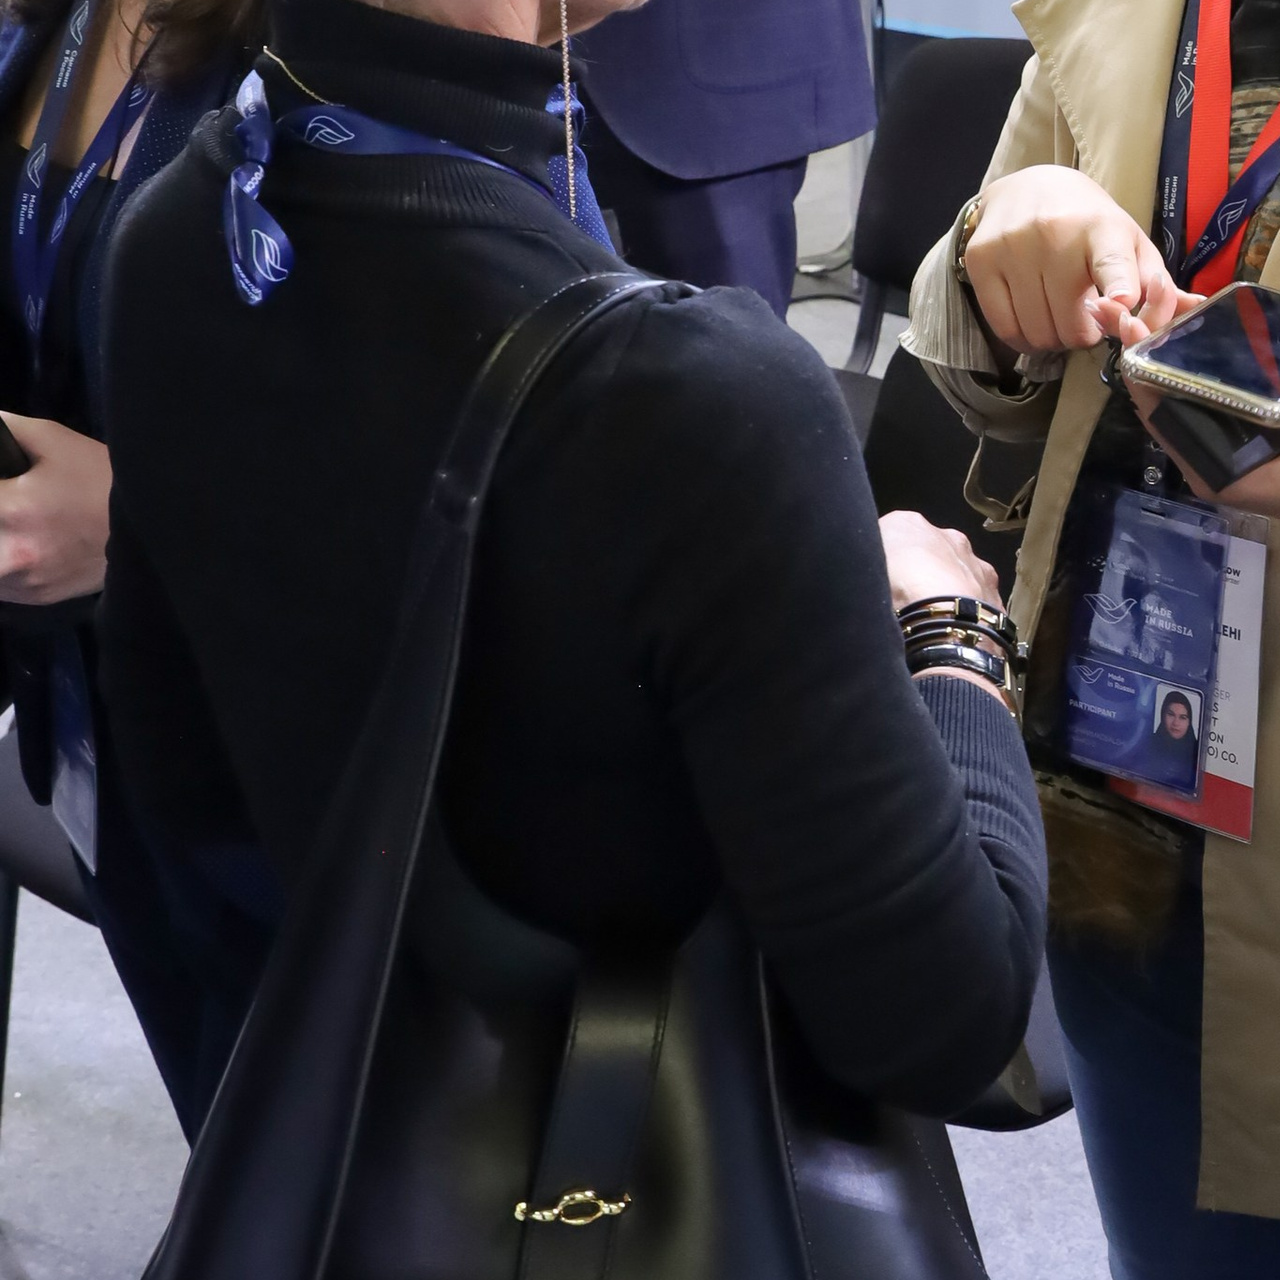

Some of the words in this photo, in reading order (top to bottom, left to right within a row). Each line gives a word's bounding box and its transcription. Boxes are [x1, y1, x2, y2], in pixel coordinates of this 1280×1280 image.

[1182, 40, 1194, 66] Made
[1169, 175, 1179, 210] России
[1145, 603, 1173, 619] MADE
[1145, 614, 1157, 626] IN
[1158, 619, 1194, 638] RUSSIA
[1107, 672, 1126, 683] Made
[1114, 682, 1136, 695] Russia
[1068, 698, 1117, 719] PARTICIPANT
